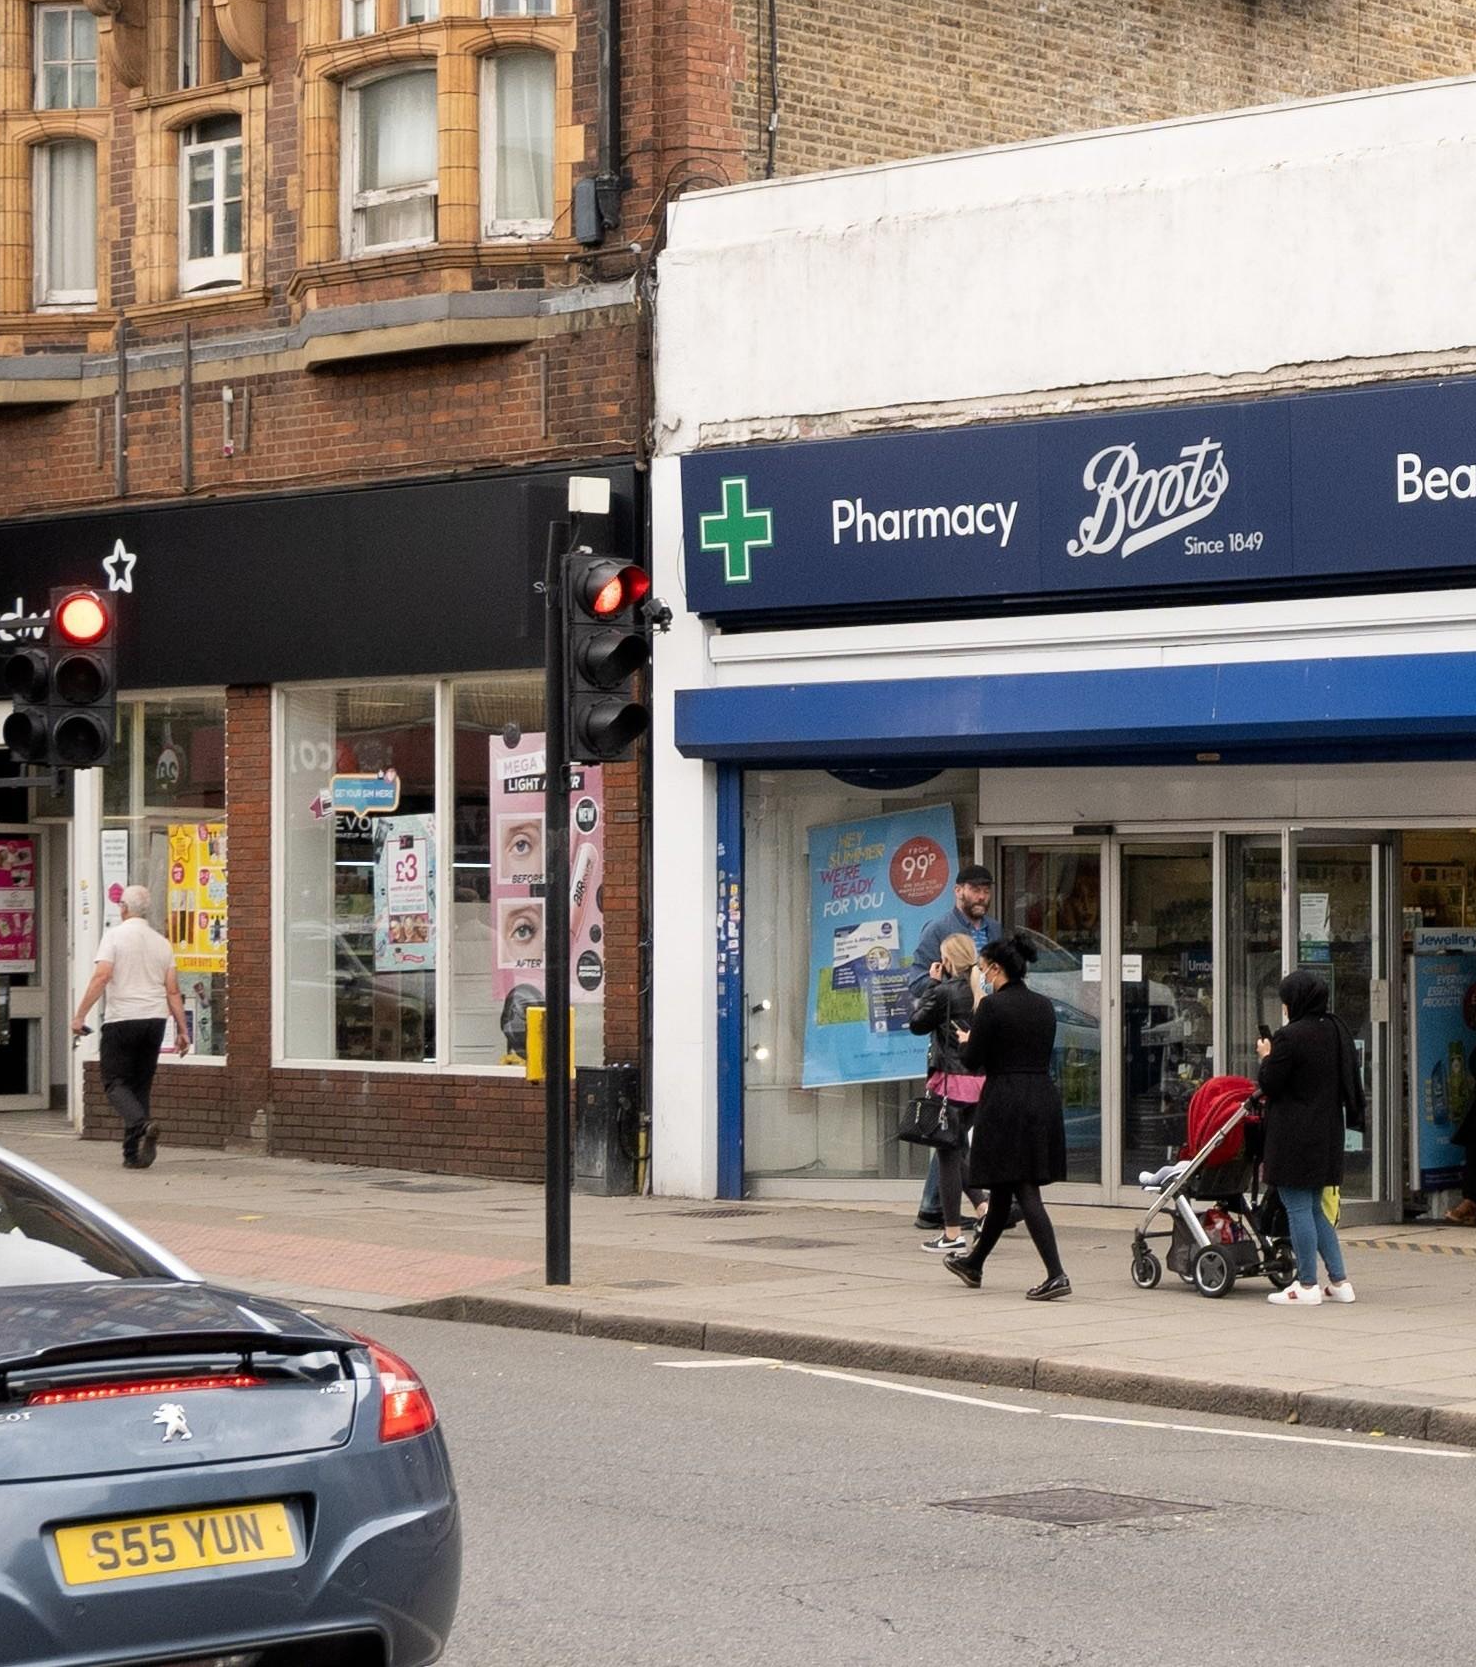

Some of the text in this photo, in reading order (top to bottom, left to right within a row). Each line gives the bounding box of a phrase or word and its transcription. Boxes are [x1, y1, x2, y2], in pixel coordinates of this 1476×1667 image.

[1066, 436, 1229, 559] Boots
[832, 498, 1018, 547] Pharmacy
[1184, 532, 1264, 556] Since 1849
[503, 756, 537, 774] MEGA
[346, 789, 361, 798] YOUR
[375, 789, 394, 798] HERE
[508, 777, 540, 791] LIGHT
[578, 808, 594, 822] NEW
[838, 831, 865, 849] HEY
[828, 844, 885, 867] SUMMER
[396, 853, 418, 882] £3
[820, 863, 861, 884] WE'RE
[512, 874, 544, 884] BEFORE
[832, 879, 875, 899] READY
[824, 892, 884, 917] FOR YOU
[516, 958, 542, 968] AFTER
[91, 1512, 266, 1572] S55 YUN
